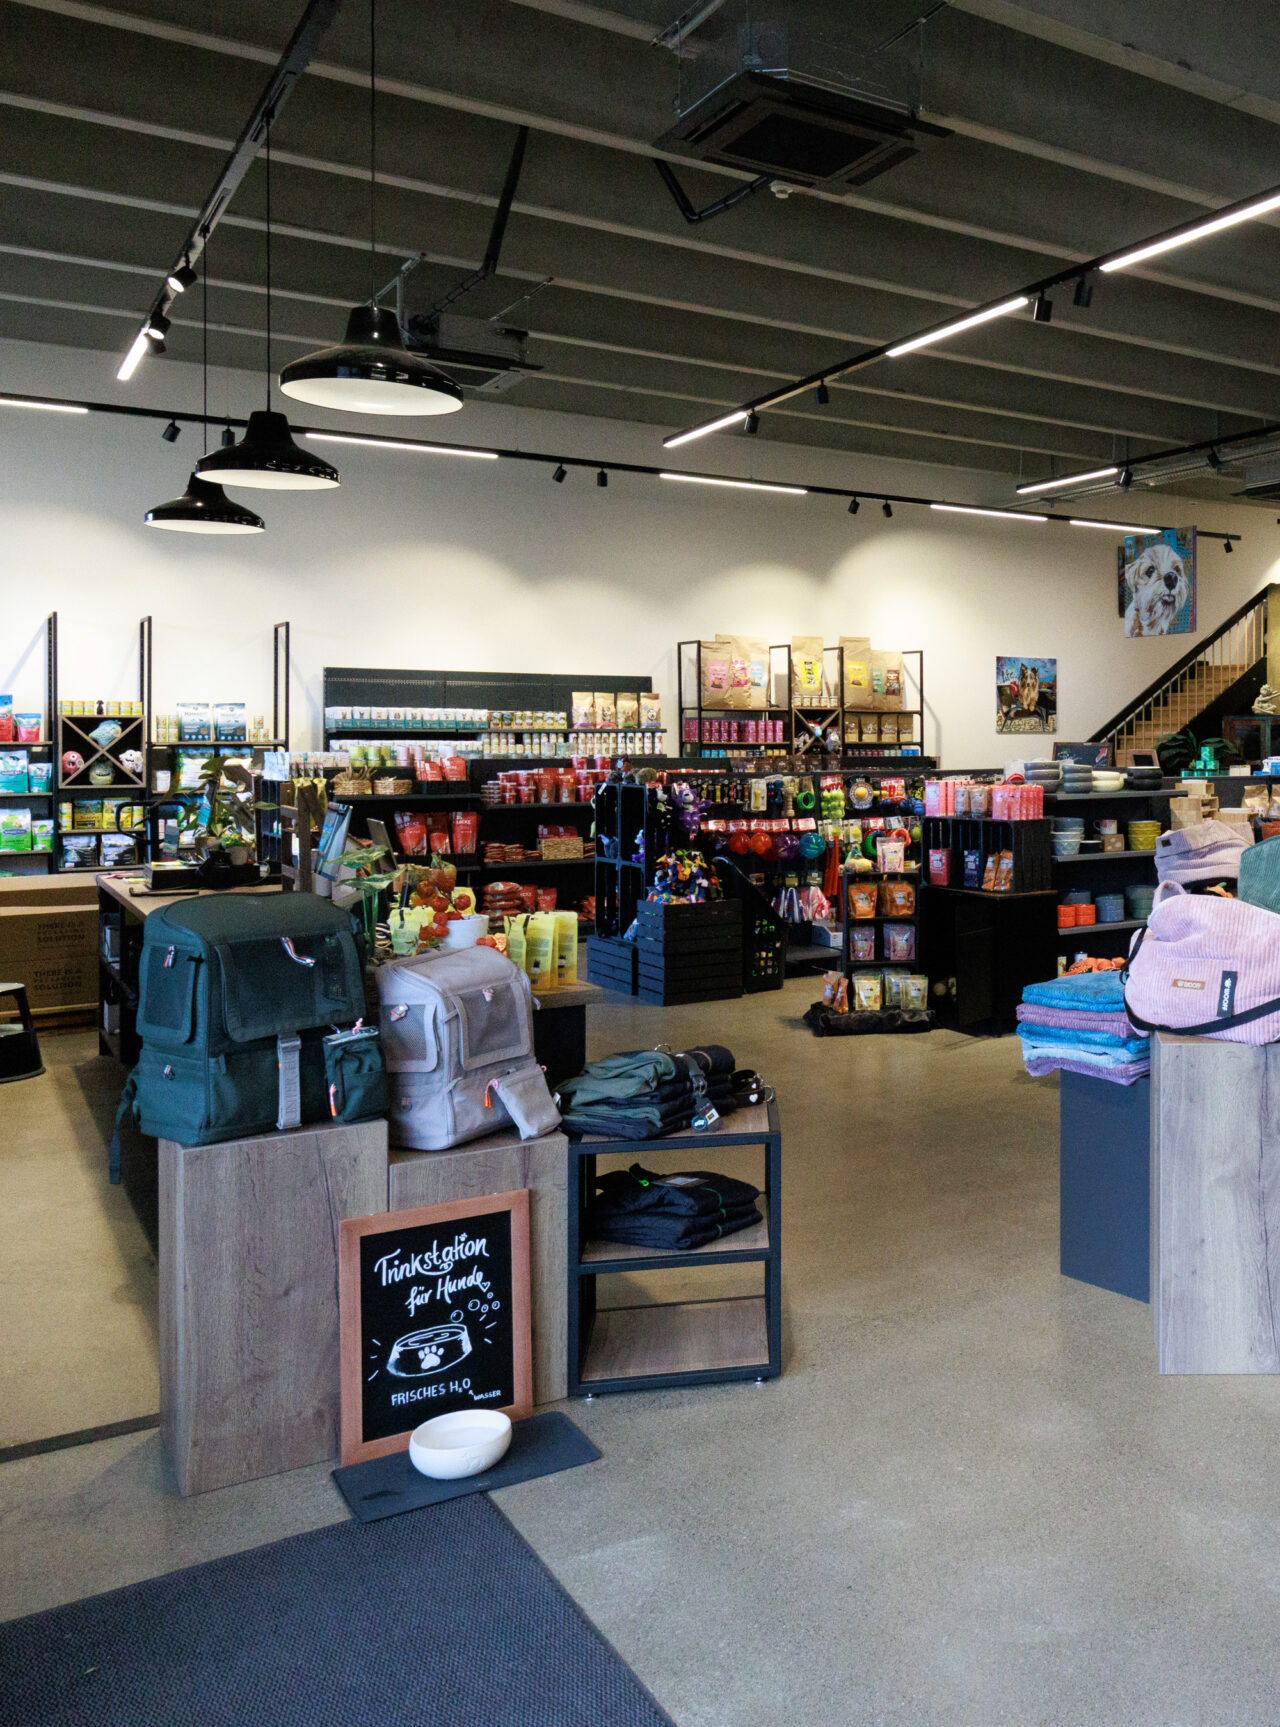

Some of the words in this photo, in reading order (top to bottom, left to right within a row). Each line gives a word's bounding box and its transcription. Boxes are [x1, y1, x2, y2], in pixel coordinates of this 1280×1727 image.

[374, 1233, 490, 1286] Trinkstation
[405, 1286, 432, 1317] für
[436, 1265, 484, 1304] Hunde
[391, 1381, 446, 1406] FRISCHES
[474, 1389, 501, 1401] WASSER
